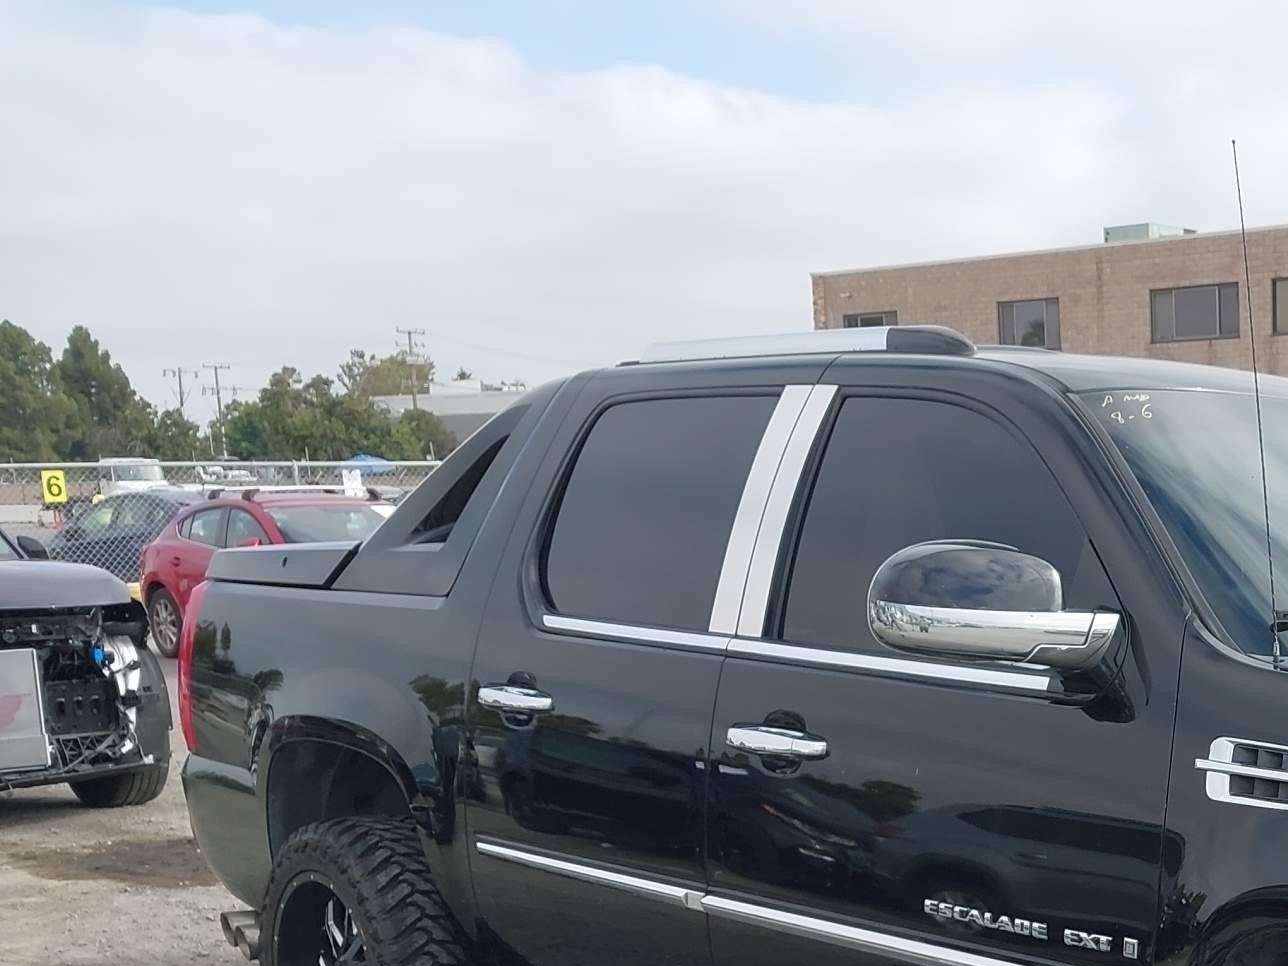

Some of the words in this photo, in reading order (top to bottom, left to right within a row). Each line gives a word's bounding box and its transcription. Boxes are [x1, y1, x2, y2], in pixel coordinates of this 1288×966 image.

[46, 475, 62, 497] 6
[924, 899, 1049, 940] ESCALADE
[1063, 928, 1113, 952] EXT
